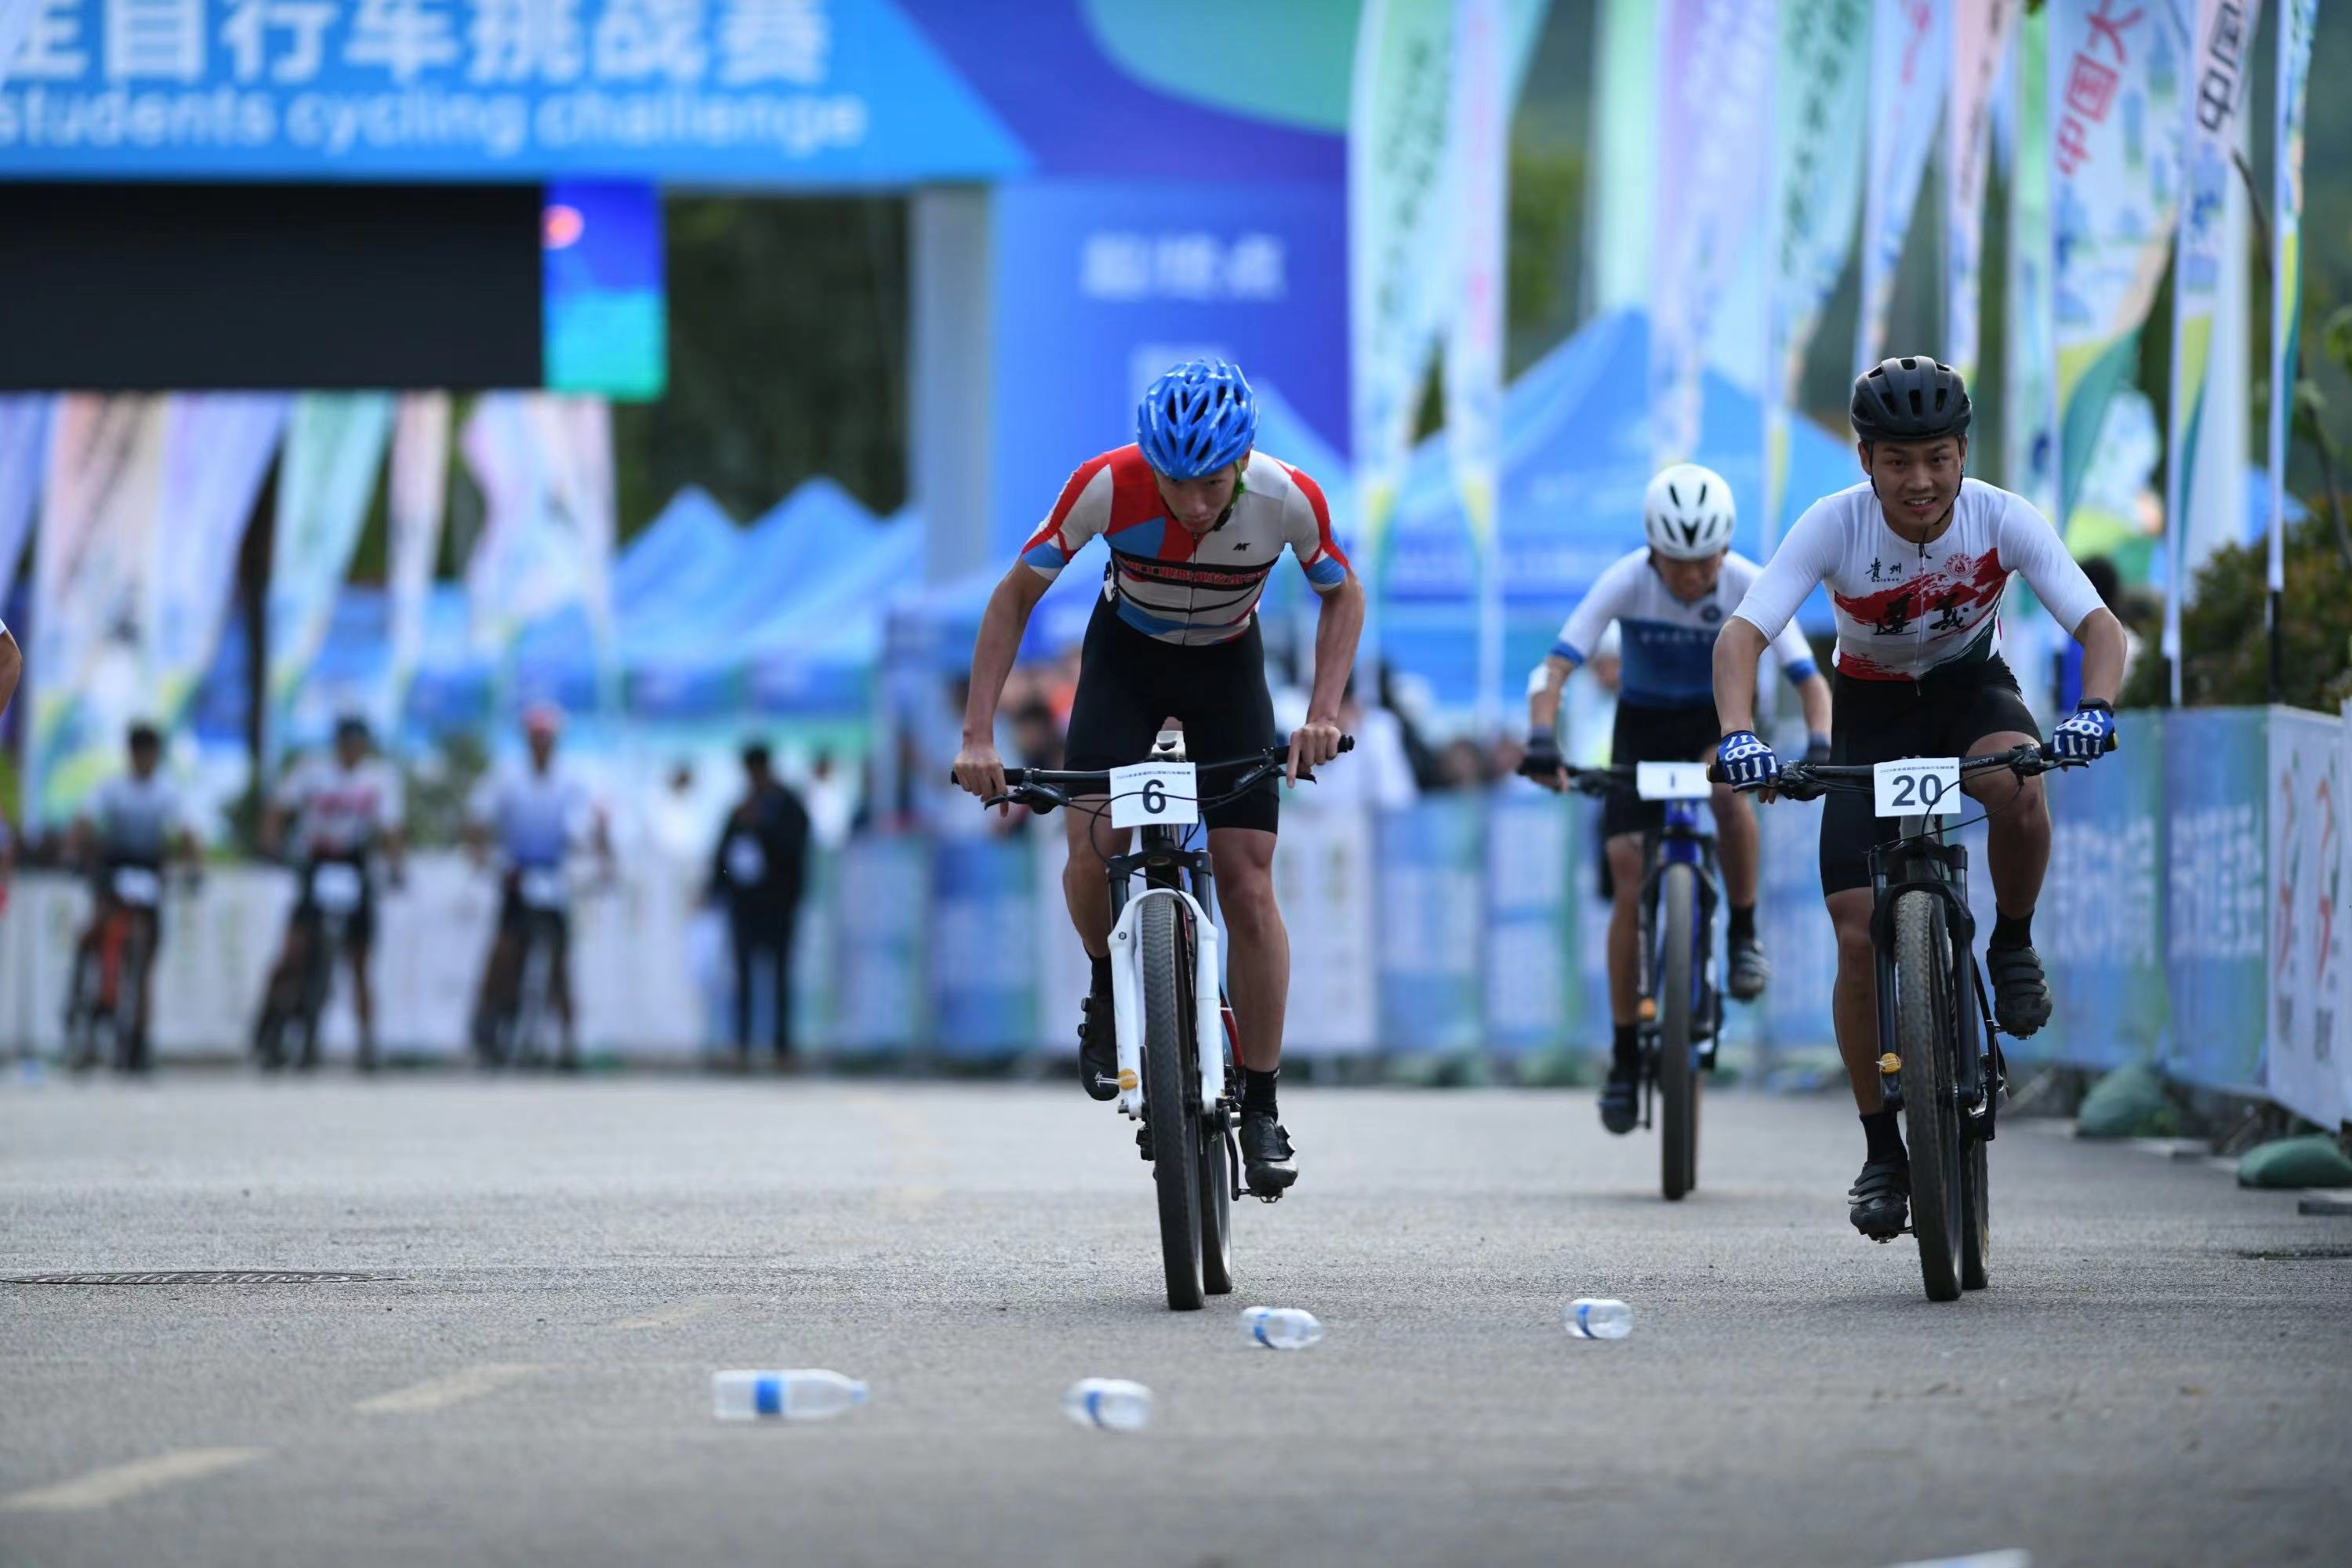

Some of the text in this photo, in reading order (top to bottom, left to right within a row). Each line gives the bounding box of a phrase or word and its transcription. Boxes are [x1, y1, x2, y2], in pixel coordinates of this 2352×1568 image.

[285, 83, 527, 159] cycling
[535, 85, 867, 159] challenge
[1142, 779, 1167, 814] 6
[1892, 774, 1942, 807] 20
